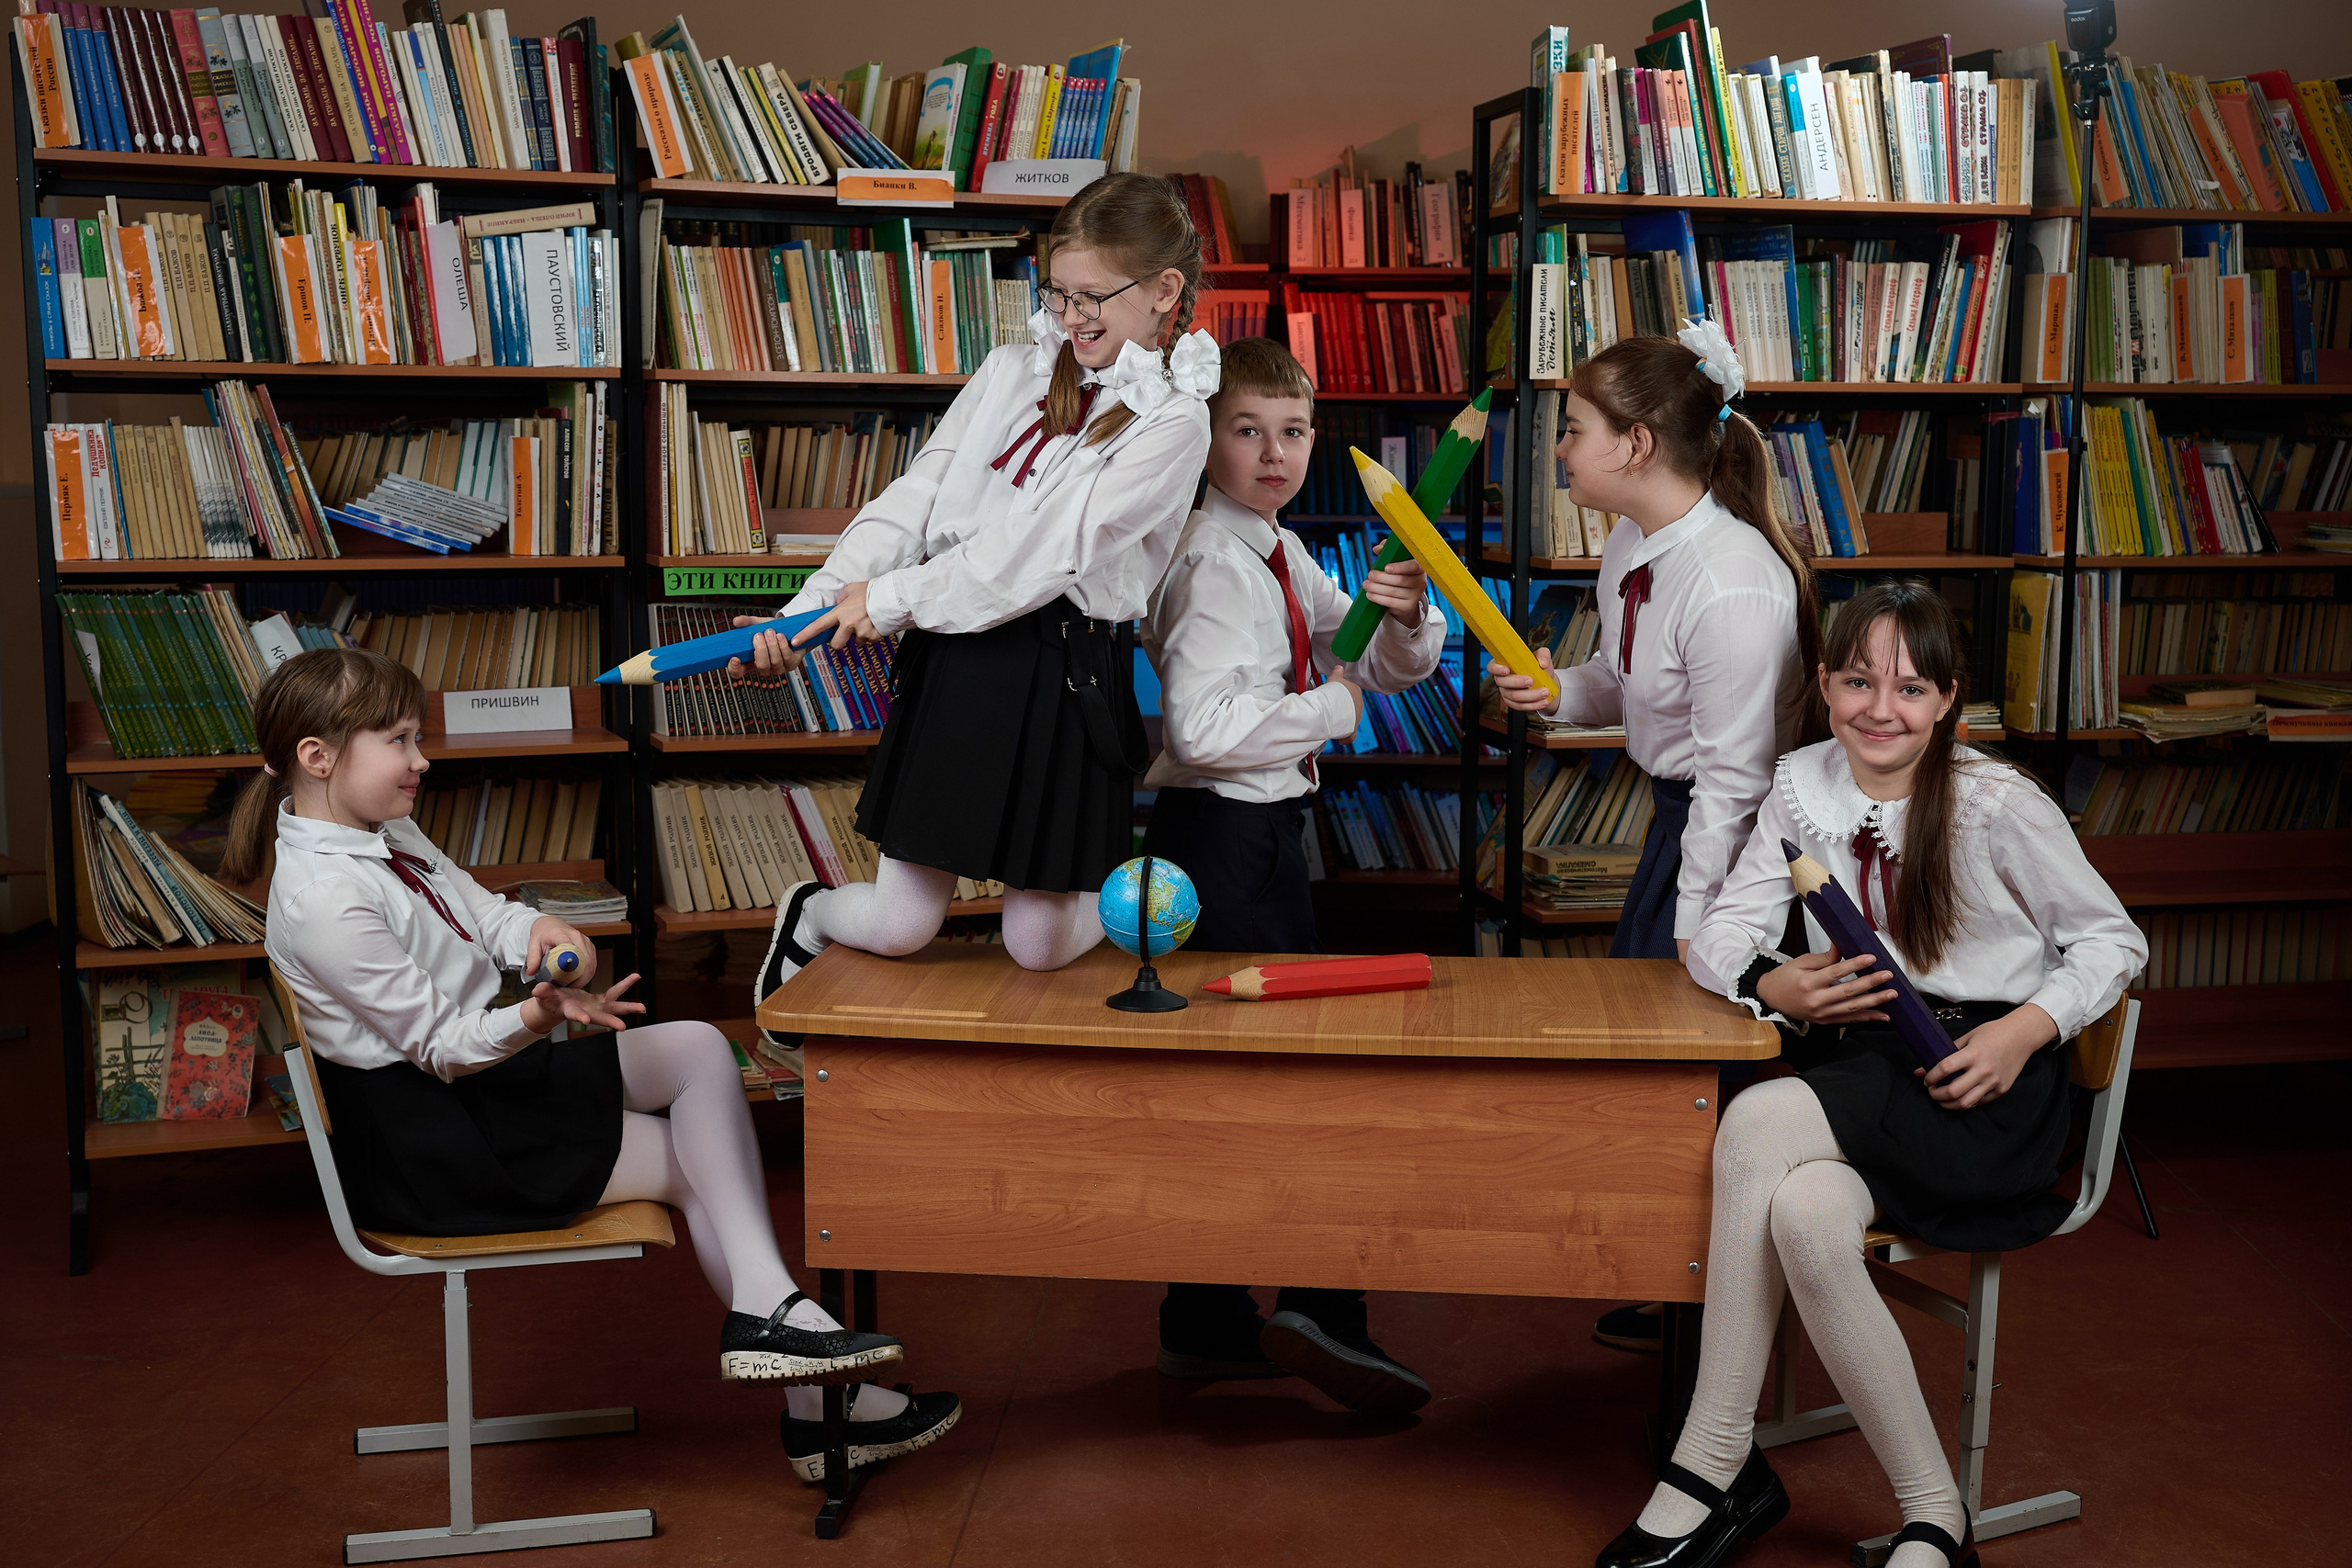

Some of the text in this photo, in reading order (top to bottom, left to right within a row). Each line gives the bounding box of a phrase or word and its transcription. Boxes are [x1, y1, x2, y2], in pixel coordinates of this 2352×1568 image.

[46, 59, 56, 91] России
[299, 73, 307, 84] ЗА
[317, 73, 325, 84] ЗА
[334, 0, 379, 136] КАЗКИ НАРОДОВ РОССИИ
[339, 82, 348, 93] ЗА
[374, 49, 393, 99] НАРОДОВ
[1720, 68, 1729, 97] СОЛОВЕЙ
[30, 47, 51, 134] Сказки писателей
[643, 72, 659, 108] природе
[989, 99, 999, 118] ГОДА
[311, 116, 320, 127] ЗА
[329, 116, 337, 127] ЗА
[351, 126, 359, 137] ЗА
[390, 110, 405, 143] СКАЗКИ
[655, 118, 672, 160] Рассказы
[776, 92, 821, 177] БРОДЯГИ СЕВЕРА
[983, 123, 993, 155] ВРЕМЕНА
[1558, 98, 1570, 185] Сказки зарубежных
[1571, 111, 1579, 154] писателей
[1772, 97, 1793, 182] СКАЗКИ СТАРОЙ АНГЛИИ
[1812, 103, 1829, 171] АНДЕРСЕН
[1962, 106, 1970, 147] СТРАНА
[1016, 130, 1024, 158] ЖИТКОВ
[2098, 140, 2112, 181] Сборники
[2205, 137, 2224, 172] А. Барто
[874, 180, 917, 191] Бианки В.
[1015, 173, 1069, 184] ЖИТКОВ
[1347, 208, 1355, 241] Физика
[1430, 193, 1442, 241] География
[296, 279, 312, 323] Ершов П.
[451, 257, 469, 310] ОЛЕША
[546, 249, 571, 352] ПАУСТОВСКИЙ
[937, 293, 944, 302] Н.
[1883, 278, 1899, 333] Сельма Лагерлёф
[1907, 278, 1924, 332] Сельма Лагерлёф
[1297, 321, 1306, 364] Биология
[2050, 303, 2062, 354] С. Маршак
[2177, 296, 2187, 361] В. Маяковский
[2228, 349, 2235, 358] С.
[60, 473, 73, 521] Пермяк Е.
[516, 472, 523, 481] А.
[2055, 473, 2065, 532] К. Чуковский
[668, 571, 805, 591] ЭТИ КНИГИ
[471, 695, 539, 709] ПРИШВИН
[2273, 720, 2321, 729] Почемучкины
[665, 816, 680, 869] ЖИВОЙ РОДНИК
[682, 816, 698, 868] ЖИВОЙ РОДНИК
[699, 817, 717, 866] ЖИВОЙ РОДНИК
[729, 814, 752, 865] ЖИВОЙ РОДНИК
[780, 814, 804, 863] ЖИВОЙ РОДНИК
[831, 817, 854, 863] ЖИВОЙ РОДНИК
